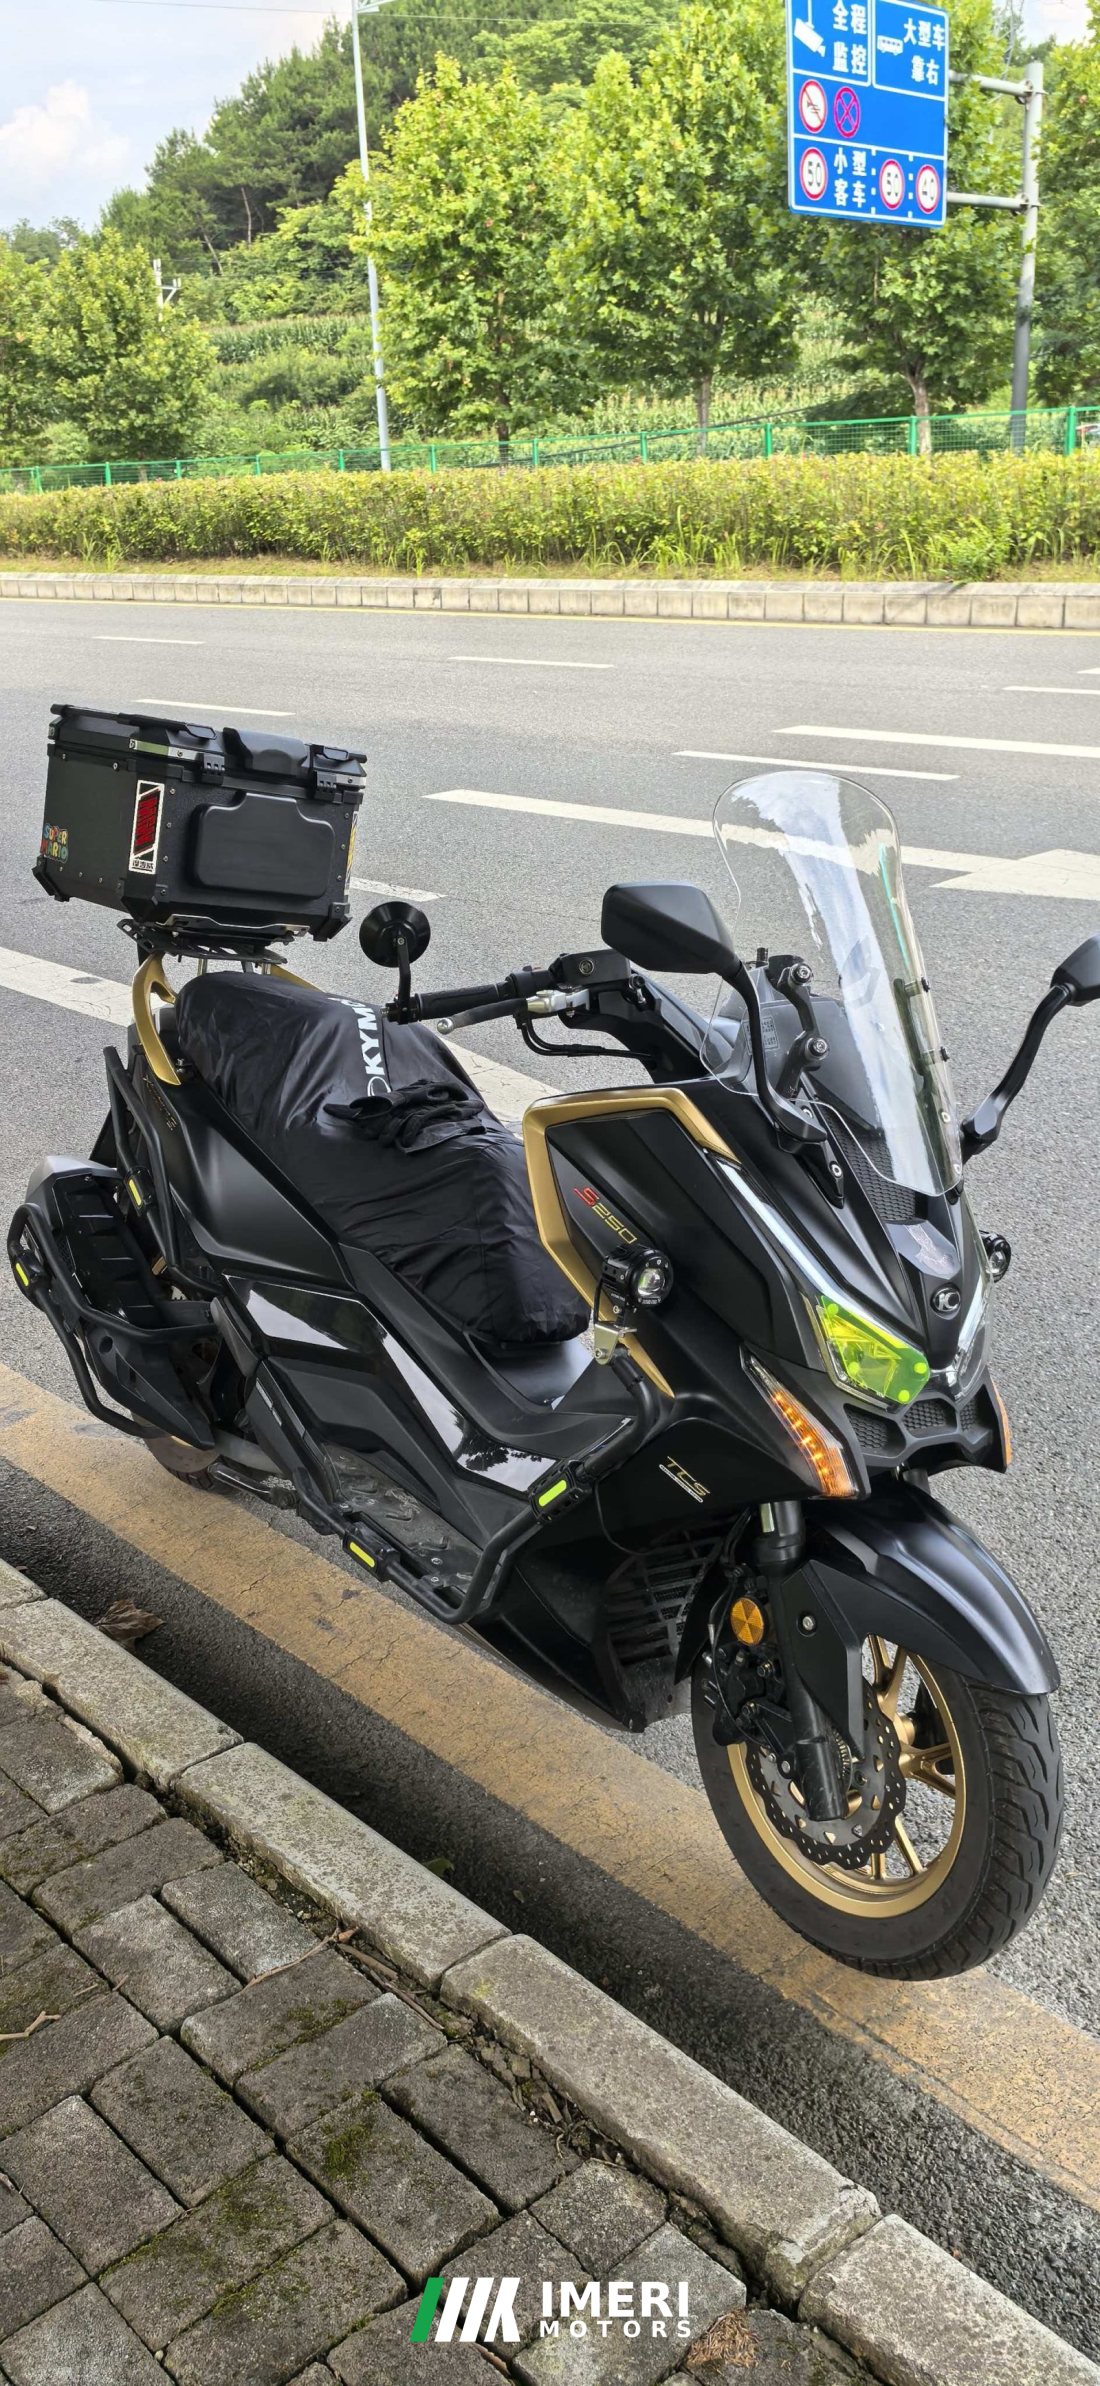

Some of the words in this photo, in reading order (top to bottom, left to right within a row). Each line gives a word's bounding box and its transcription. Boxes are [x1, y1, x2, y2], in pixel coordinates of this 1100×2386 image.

[832, 0, 867, 35] 全程
[903, 17, 946, 51] 大型车
[832, 41, 867, 75] 监控
[911, 55, 940, 86] 靠右
[806, 160, 823, 188] 50
[833, 147, 868, 177] 小型
[833, 178, 867, 208] 客车
[573, 1186, 638, 1244] S250
[667, 1456, 711, 1496] TCS
